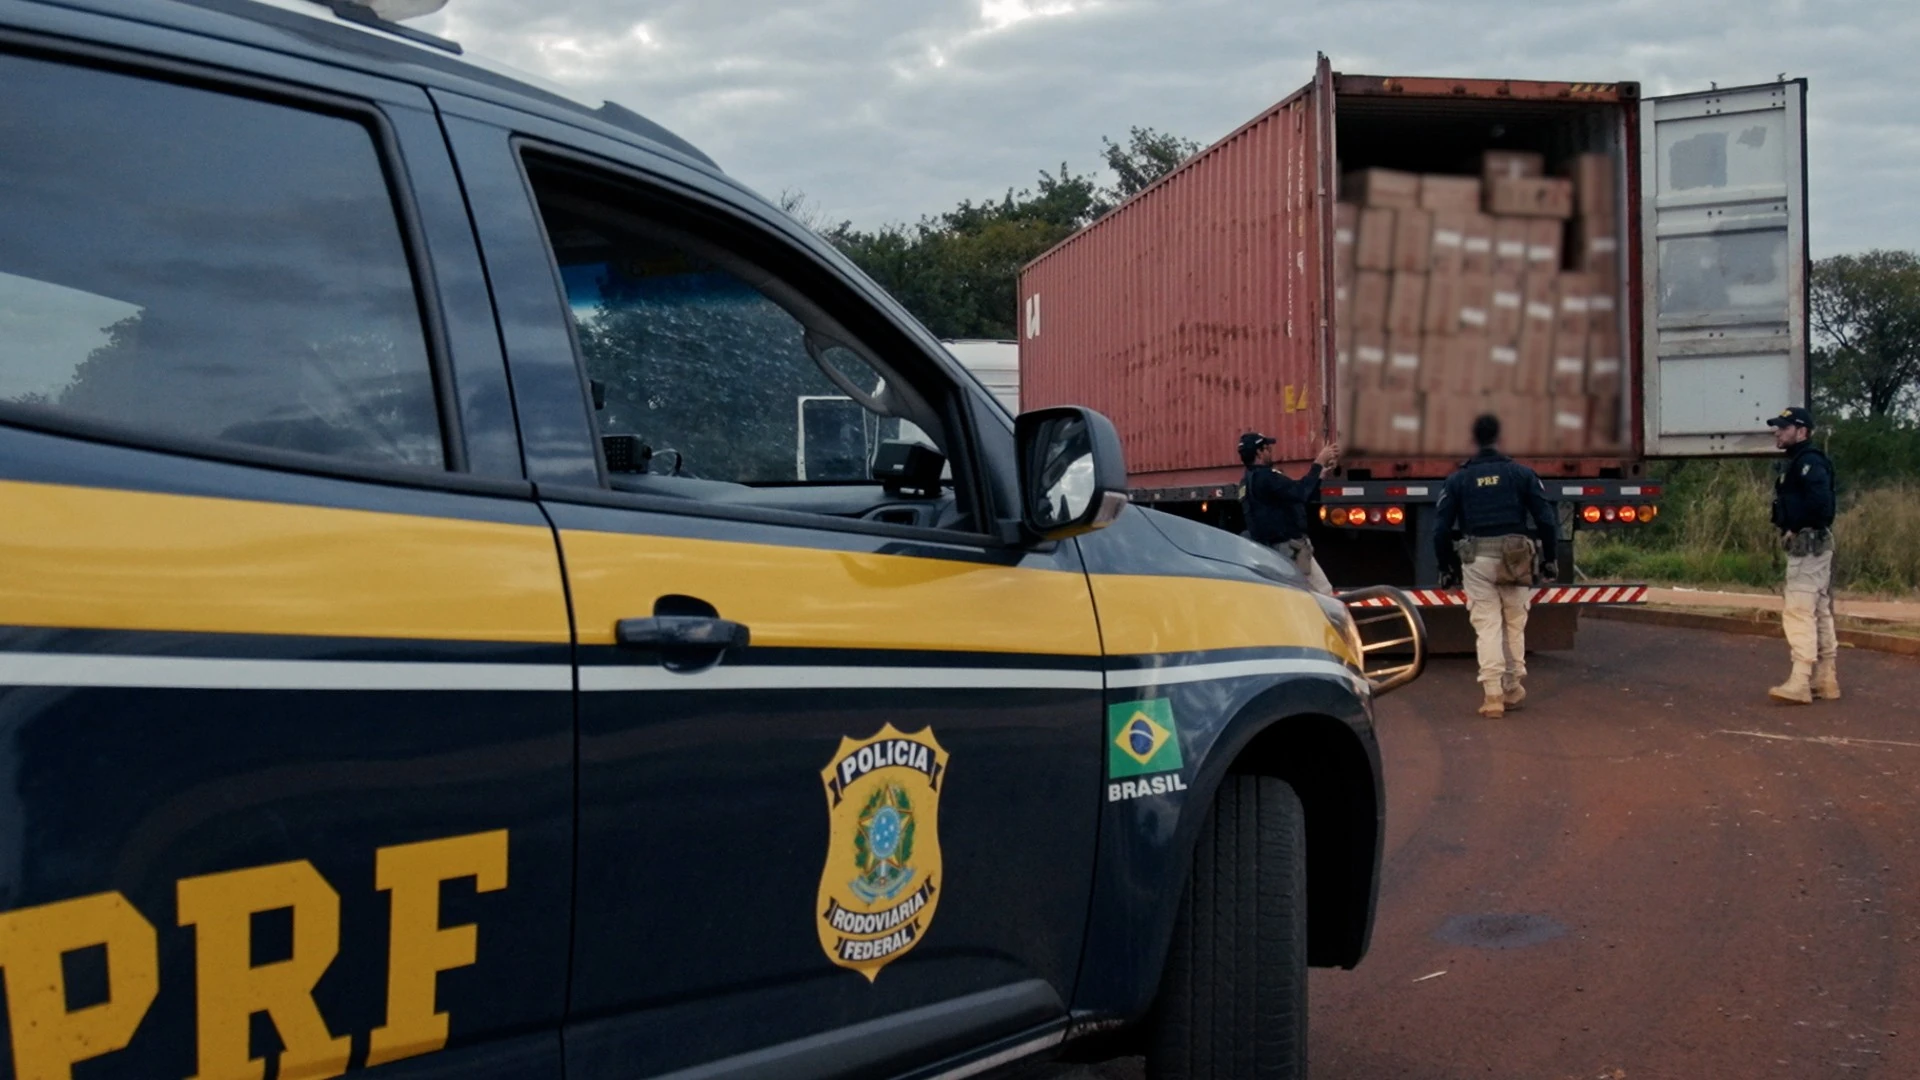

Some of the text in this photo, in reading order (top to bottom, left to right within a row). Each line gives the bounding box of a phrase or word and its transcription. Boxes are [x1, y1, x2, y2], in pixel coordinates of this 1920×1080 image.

[1476, 475, 1500, 487] PRF
[1108, 774, 1187, 802] BRASIL
[0, 829, 508, 1080] PRF
[844, 929, 911, 960] FEDERAL
